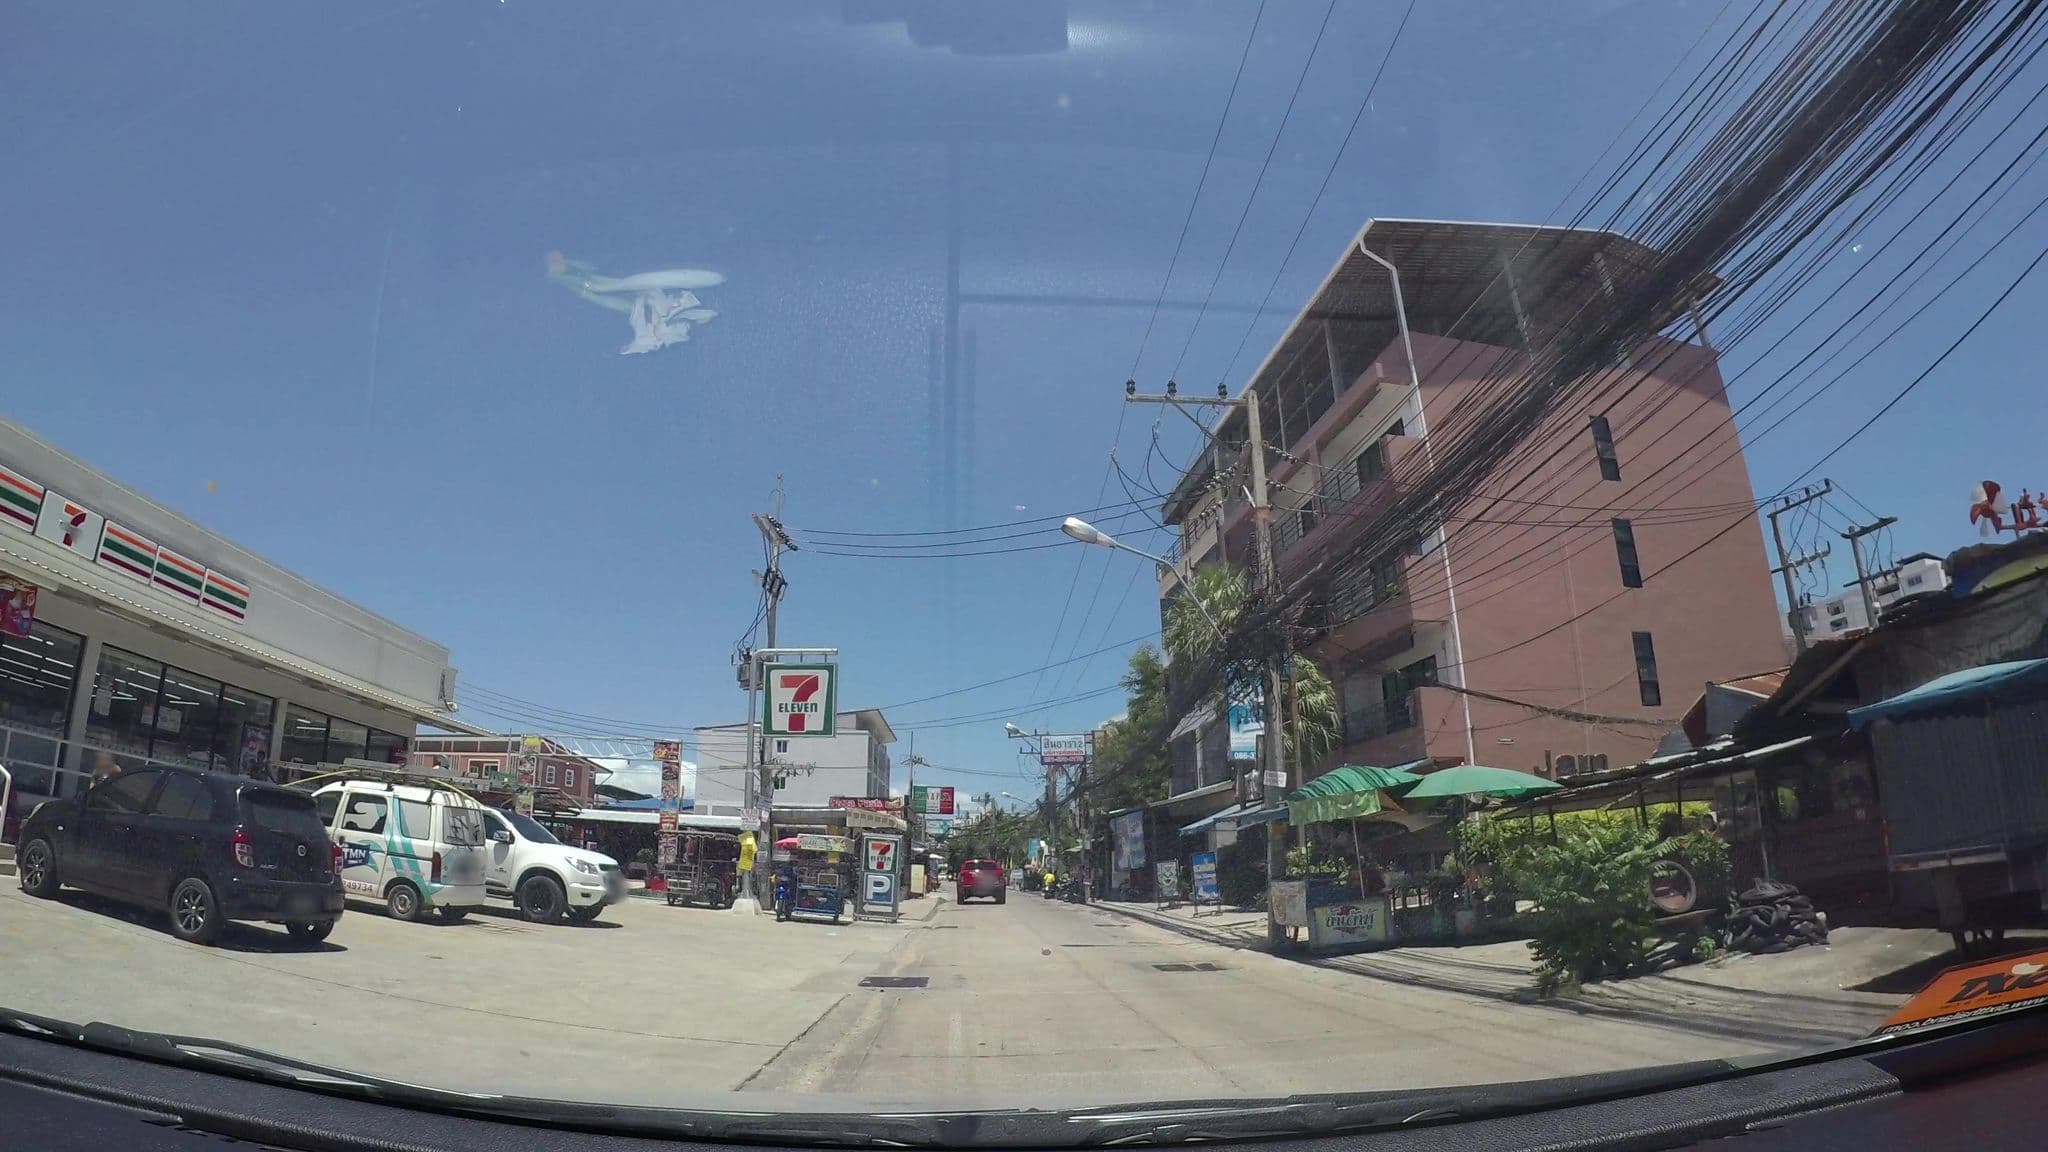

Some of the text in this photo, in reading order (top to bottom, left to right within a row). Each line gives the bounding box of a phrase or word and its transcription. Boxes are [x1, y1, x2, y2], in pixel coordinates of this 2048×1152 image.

[780, 675, 819, 732] 7
[871, 841, 891, 870] 7
[866, 874, 891, 900] P
